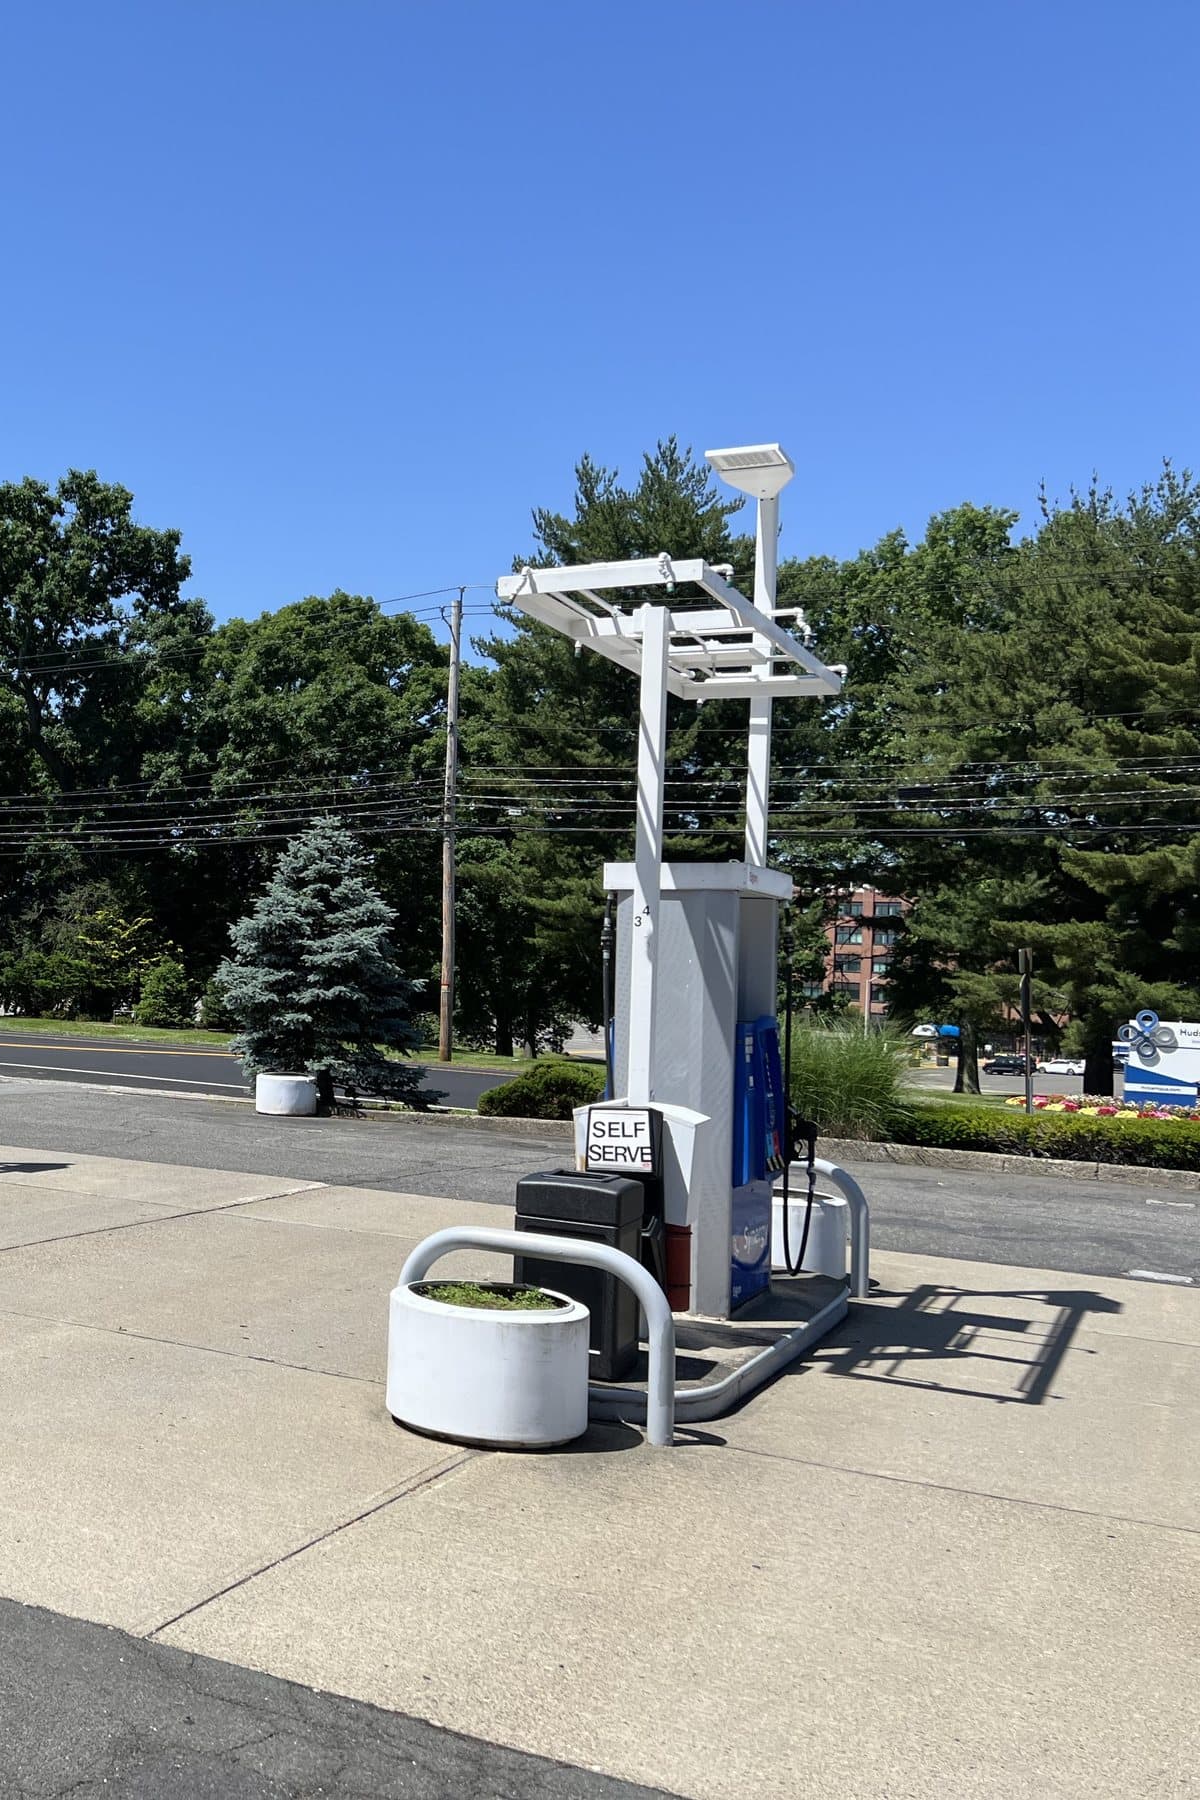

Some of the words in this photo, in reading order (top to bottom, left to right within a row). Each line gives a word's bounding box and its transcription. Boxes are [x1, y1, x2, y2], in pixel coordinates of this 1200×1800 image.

[642, 904, 650, 916] 4
[634, 915, 642, 927] 3
[1180, 1028, 1200, 1037] Hud
[592, 1120, 646, 1138] SELF
[588, 1144, 653, 1163] SERVE
